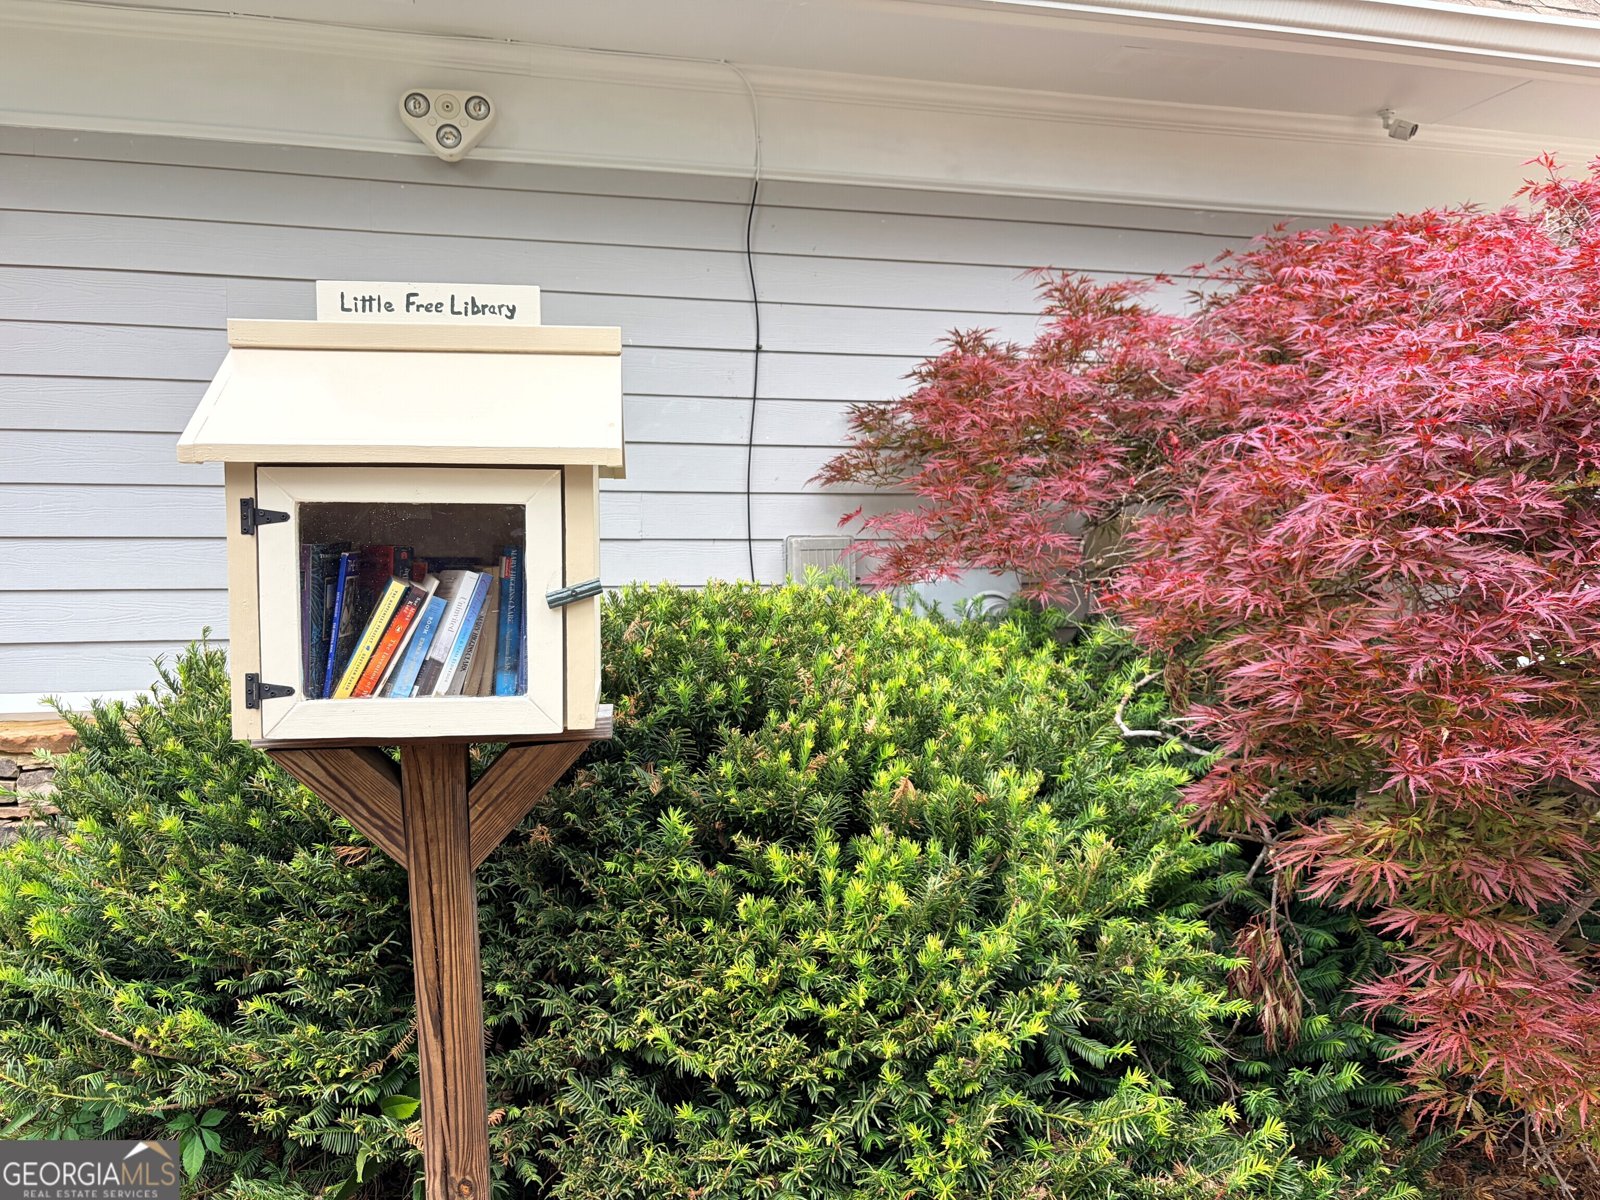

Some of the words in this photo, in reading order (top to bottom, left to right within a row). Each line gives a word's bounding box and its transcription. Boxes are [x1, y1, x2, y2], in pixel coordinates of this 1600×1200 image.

[340, 291, 395, 313] Little
[405, 292, 444, 313] Free
[450, 294, 516, 320] Library
[422, 616, 433, 635] ROOM
[448, 597, 467, 633] Uninvited
[386, 639, 396, 650] The
[370, 652, 389, 680] Invention
